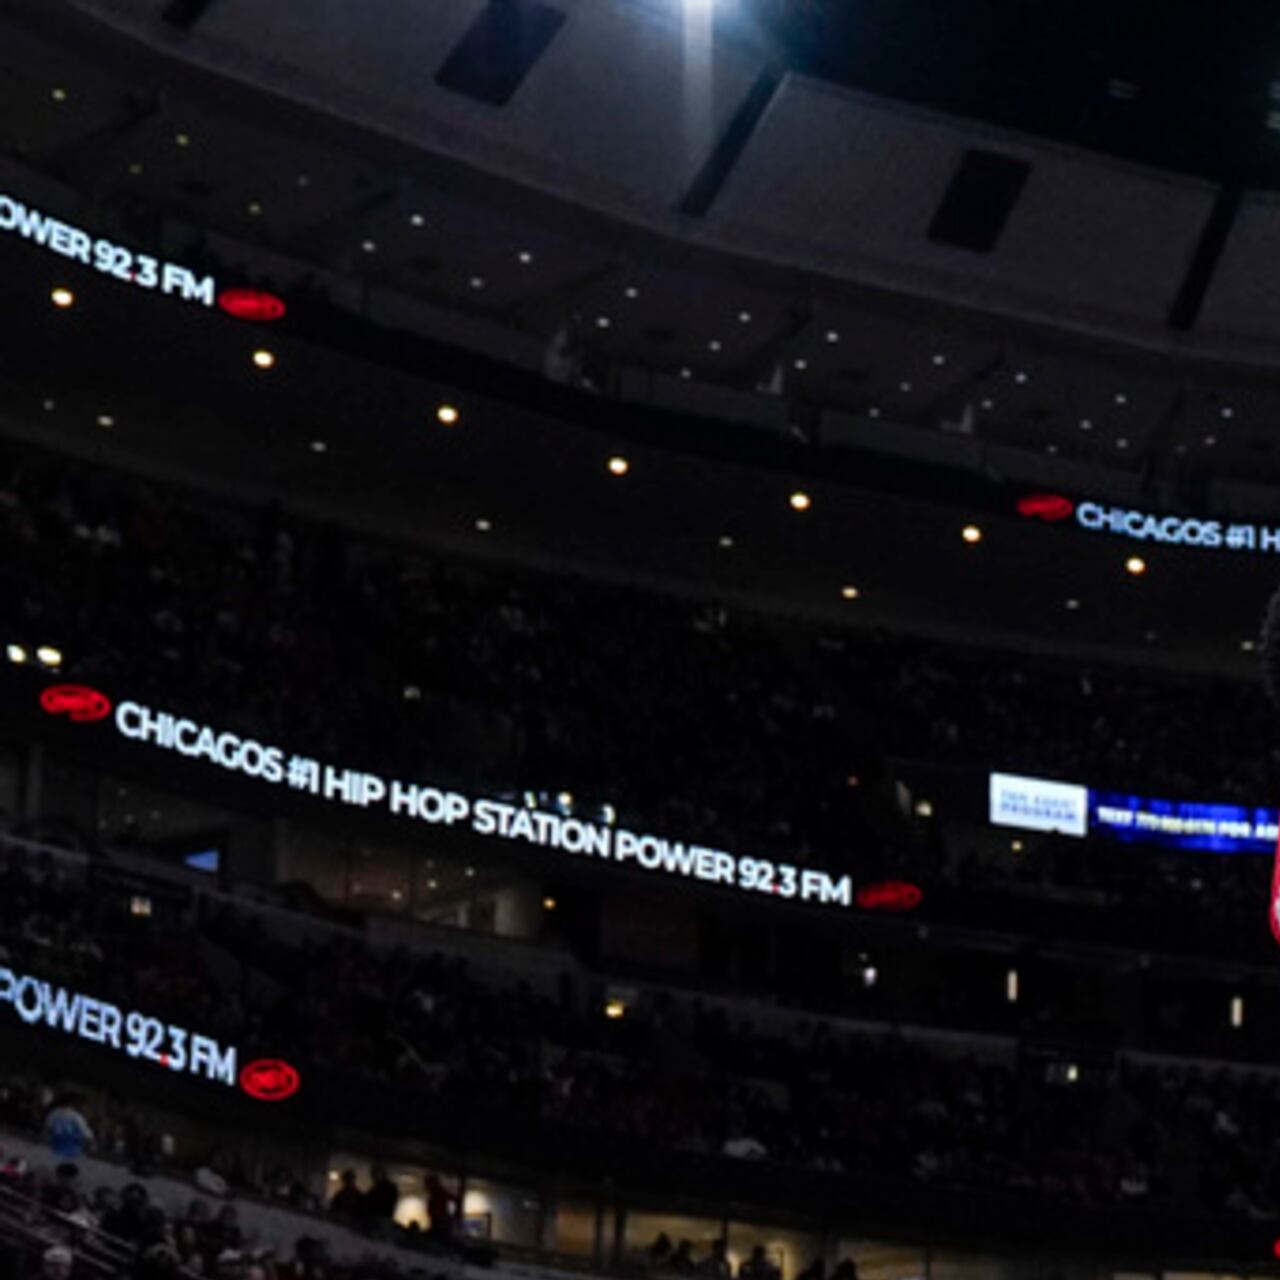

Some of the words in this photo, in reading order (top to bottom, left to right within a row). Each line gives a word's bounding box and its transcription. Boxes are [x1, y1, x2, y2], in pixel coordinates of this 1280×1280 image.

[93, 239, 159, 288] 92.3
[161, 262, 215, 306] FM
[1076, 501, 1223, 547] CHICAGOS
[1225, 524, 1256, 549] #1
[115, 700, 284, 783] CHICAGOS
[286, 754, 321, 794] #1
[324, 766, 386, 806] HIP
[390, 780, 470, 824] HOP
[472, 801, 611, 858] STATION
[614, 829, 735, 884] POWER
[737, 856, 798, 898] 92.3
[800, 869, 852, 906] FM
[125, 1011, 188, 1071] 92.3
[190, 1033, 237, 1086] FM
